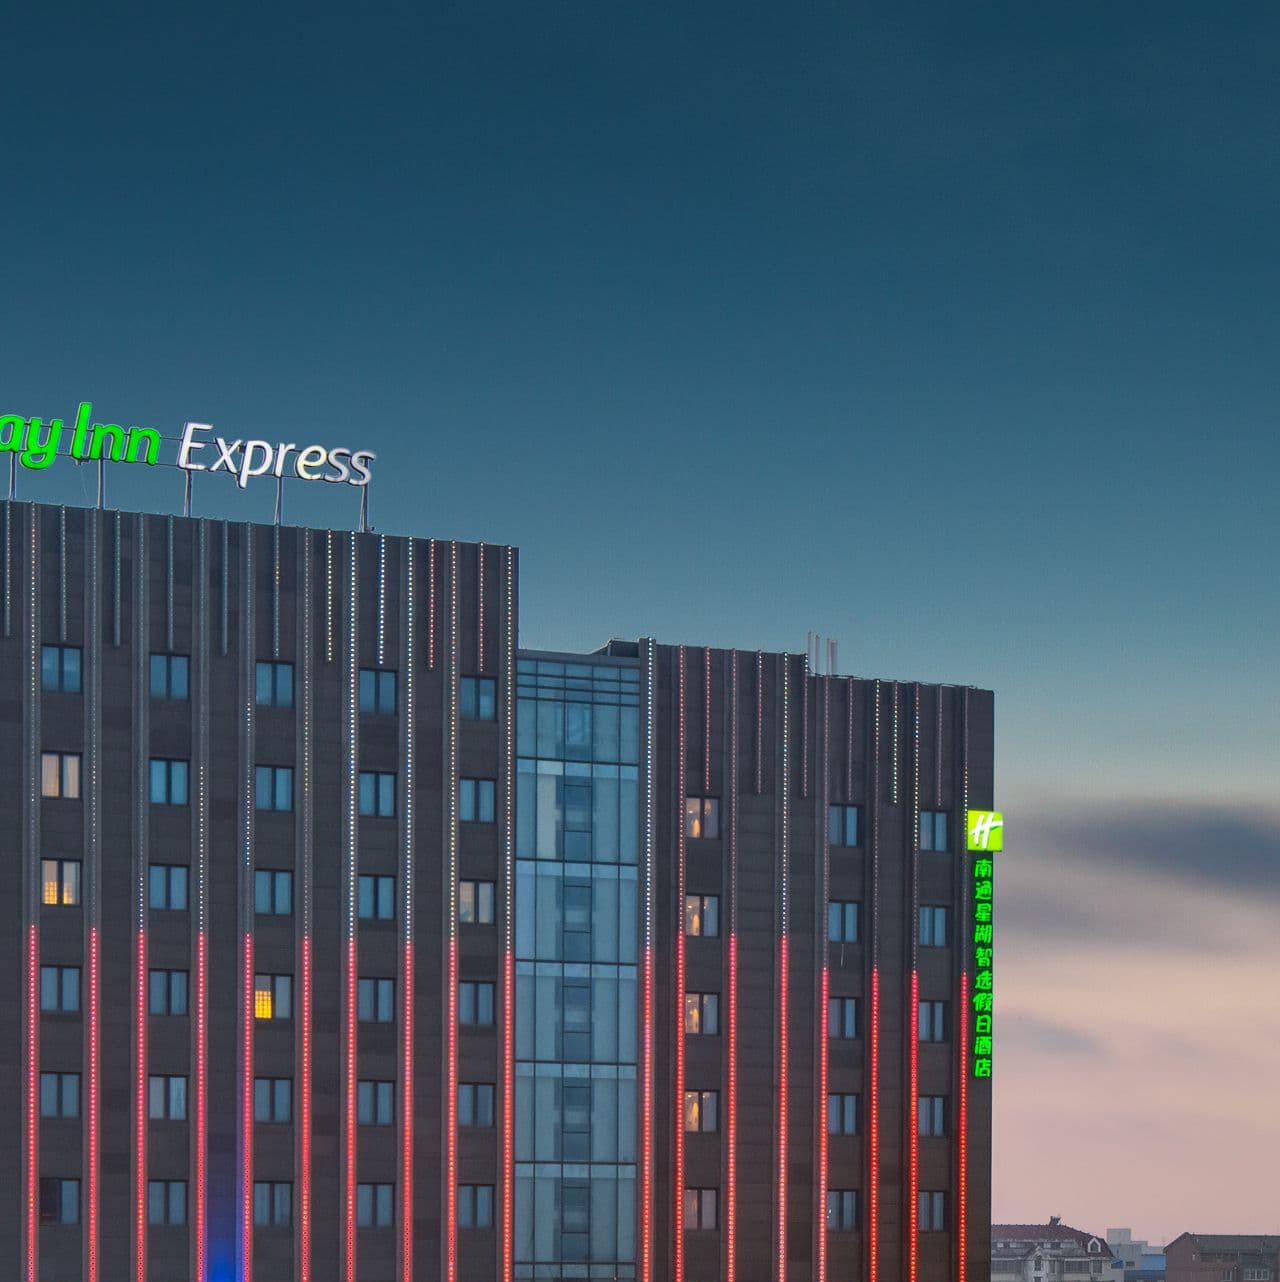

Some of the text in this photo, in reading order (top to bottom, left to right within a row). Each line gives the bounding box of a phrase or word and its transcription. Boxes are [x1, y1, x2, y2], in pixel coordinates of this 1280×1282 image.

[70, 402, 161, 465] Inn
[177, 421, 376, 488] Express
[973, 859, 993, 1078] 南通星湖智选假日酒店
